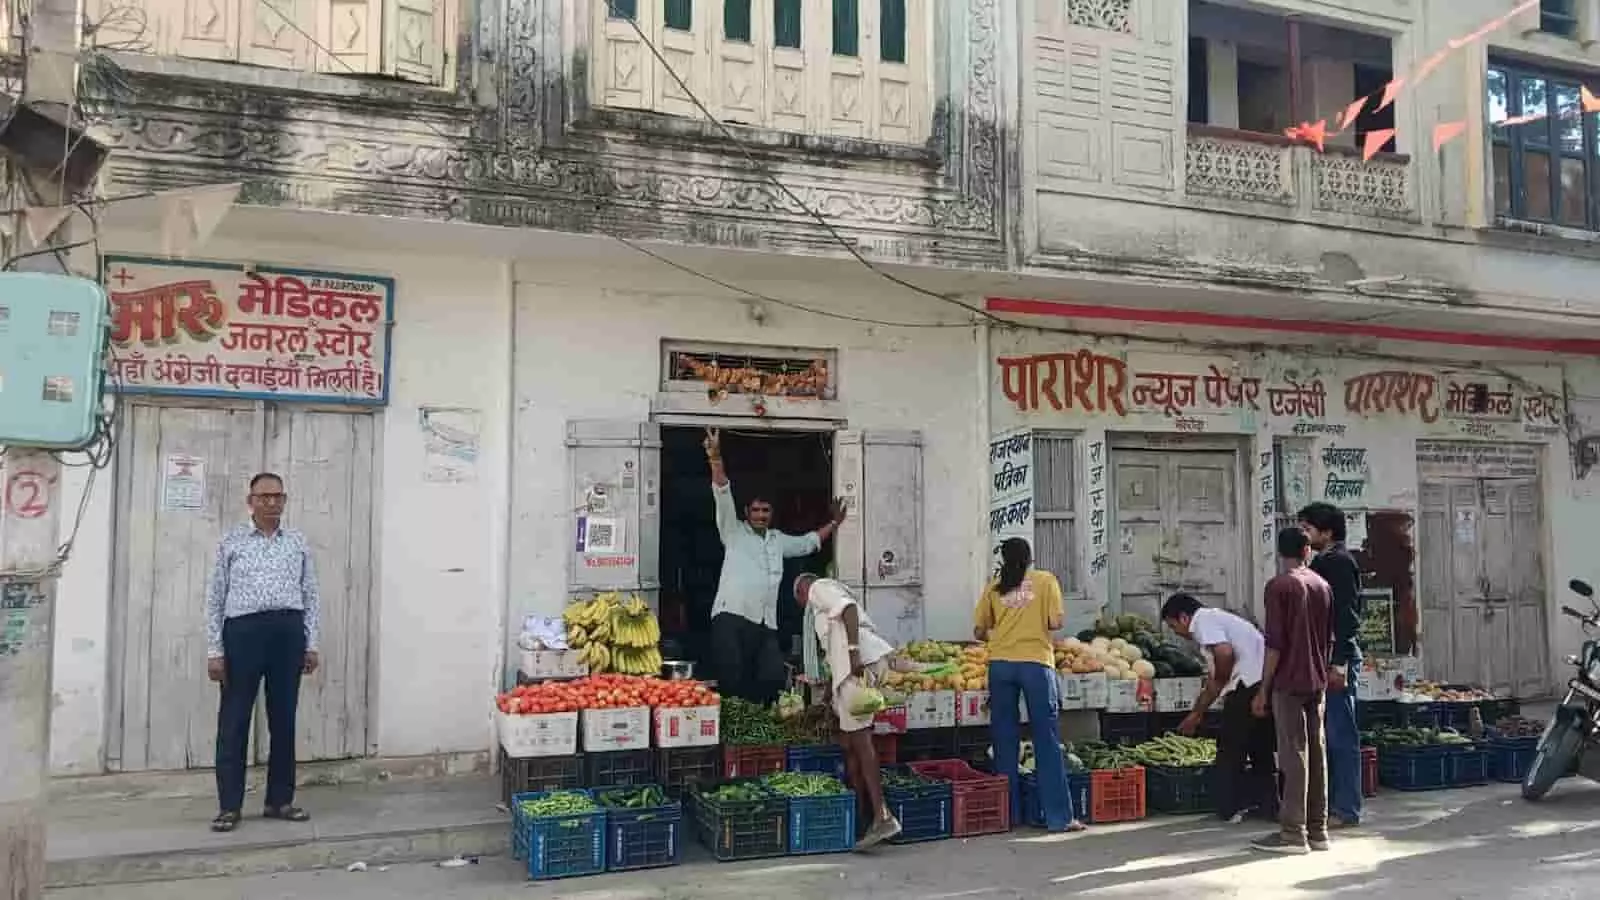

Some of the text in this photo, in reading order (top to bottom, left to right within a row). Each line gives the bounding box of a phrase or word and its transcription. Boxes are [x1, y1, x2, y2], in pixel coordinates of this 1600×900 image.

[111, 278, 224, 345] मारू
[238, 273, 383, 323] मेडिकल
[221, 321, 374, 360] जनरल स्टोर
[150, 353, 221, 387] अंग्रेजी
[224, 355, 302, 393] दवाईयाँ
[305, 361, 359, 394] मिलती
[997, 348, 1328, 418] पाराशर न्यूज पेपर एजेंसी
[1344, 370, 1439, 424] पाराशर
[1523, 385, 1561, 424] स्टोर
[990, 431, 1032, 464] राजस्थान
[994, 461, 1029, 493] पत्रिका
[18, 480, 48, 516] 2
